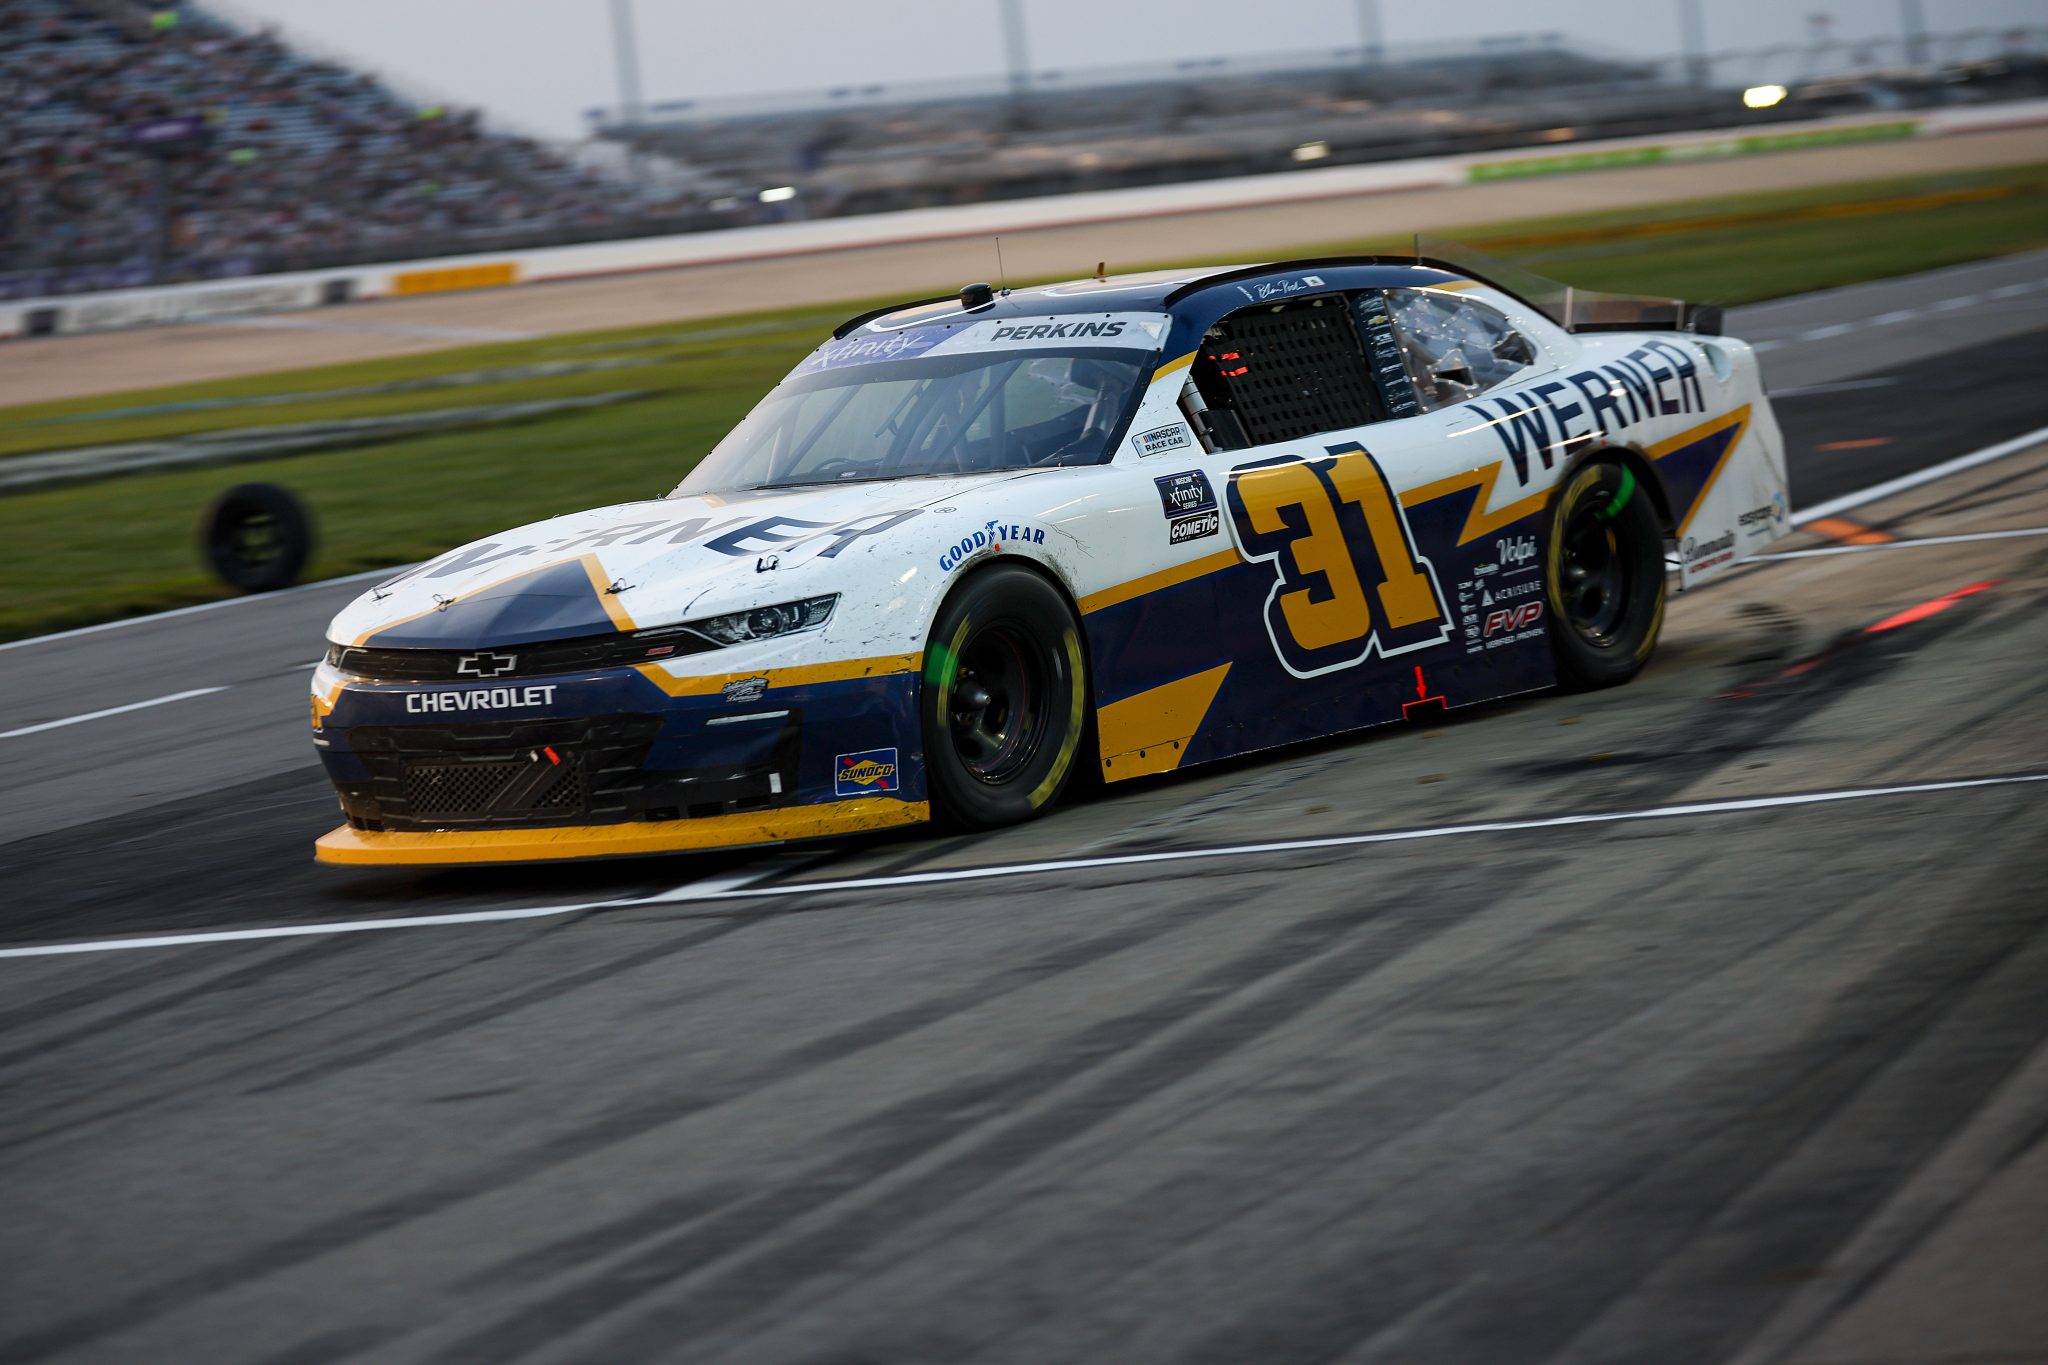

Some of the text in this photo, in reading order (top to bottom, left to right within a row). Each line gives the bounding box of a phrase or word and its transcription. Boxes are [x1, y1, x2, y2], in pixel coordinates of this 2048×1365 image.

[991, 321, 1127, 342] PERKINS
[811, 333, 925, 369] xfinity
[1465, 340, 1706, 487] WERNER
[1145, 437, 1184, 452] RACE CAR
[1150, 426, 1182, 442] NASCAR
[1169, 484, 1204, 507] xfinity
[1182, 500, 1198, 510] SERIES
[1171, 514, 1218, 539] COMETIC
[1227, 442, 1446, 660] 31
[1496, 535, 1538, 565] Volpi
[1495, 581, 1541, 601] ACRISURE
[1483, 601, 1544, 638] FVP
[406, 685, 557, 714] CHEVROLET
[840, 764, 892, 781] SUNOCO
